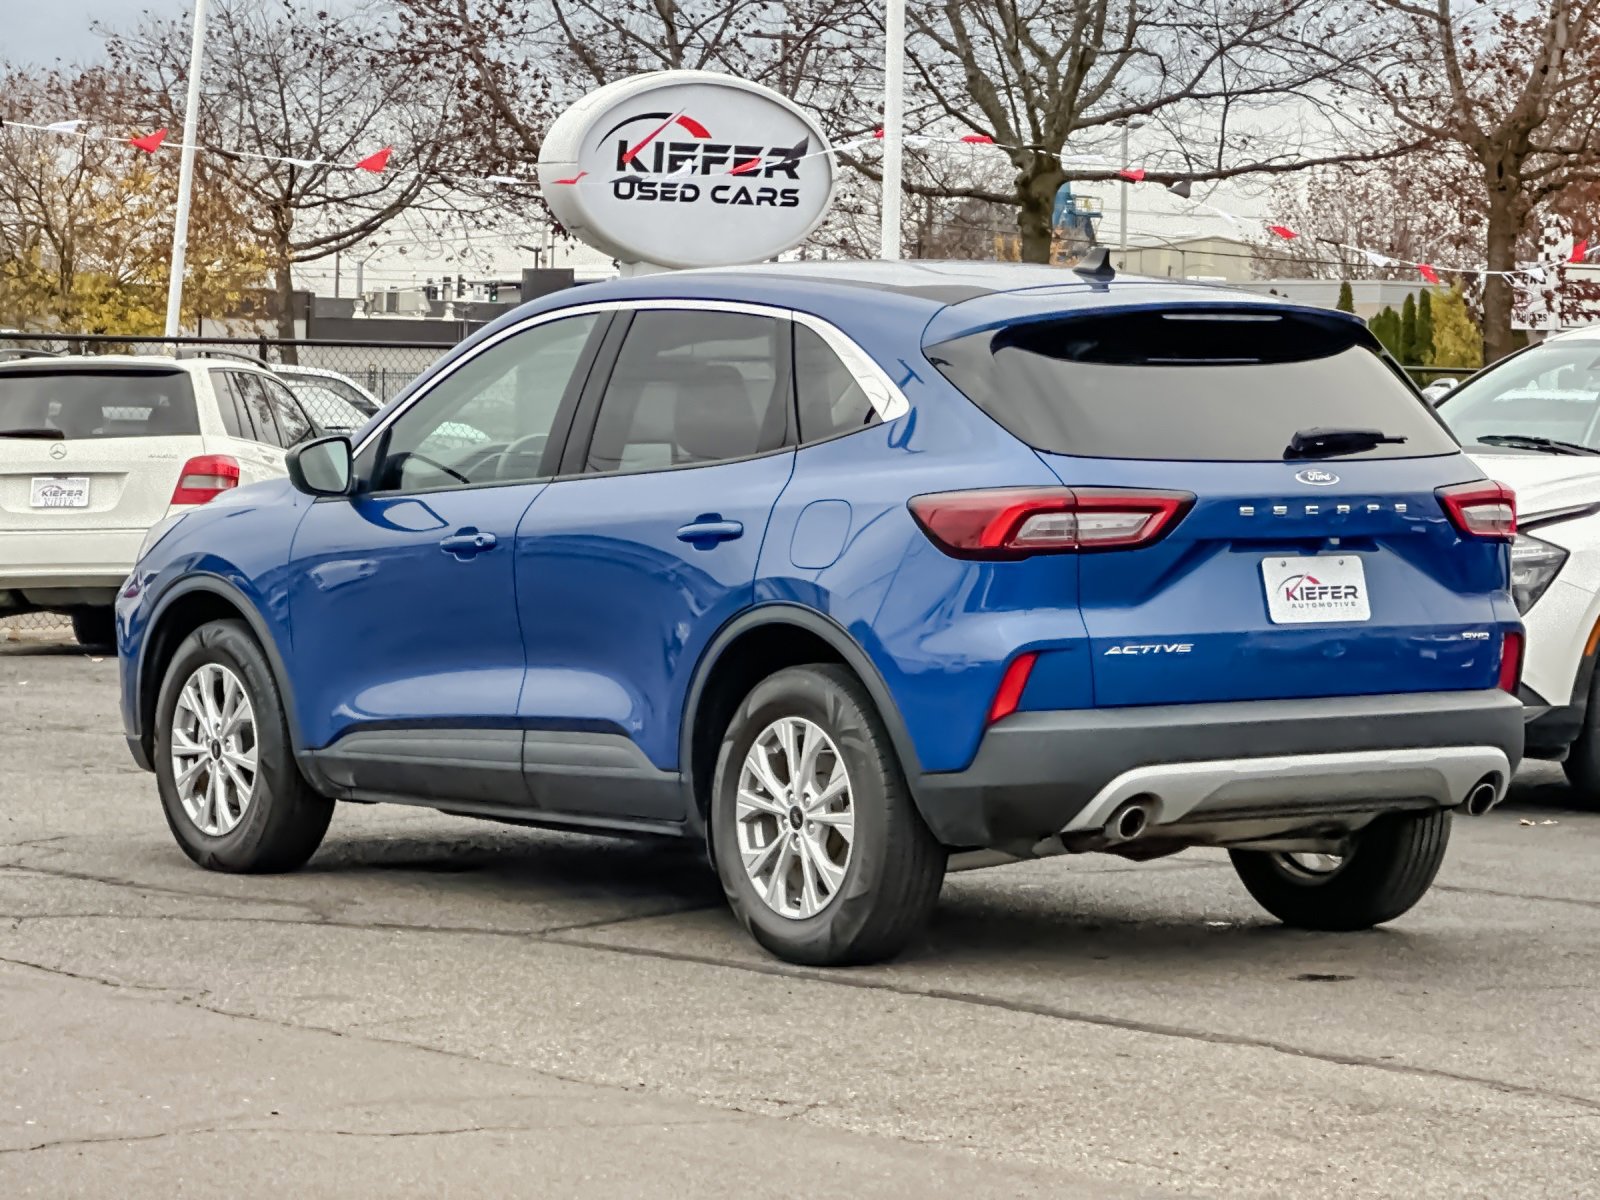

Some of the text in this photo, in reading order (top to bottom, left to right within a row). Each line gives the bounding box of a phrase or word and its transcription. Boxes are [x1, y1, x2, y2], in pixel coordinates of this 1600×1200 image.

[616, 139, 801, 180] KIEFER
[613, 180, 800, 207] USED CARS
[41, 489, 84, 497] KIEFER
[1239, 503, 1407, 516] ESCAPE
[1285, 584, 1358, 602] KIEFER
[1291, 601, 1357, 609] AUTOMOTIVE
[1103, 643, 1195, 656] ACTIVE
